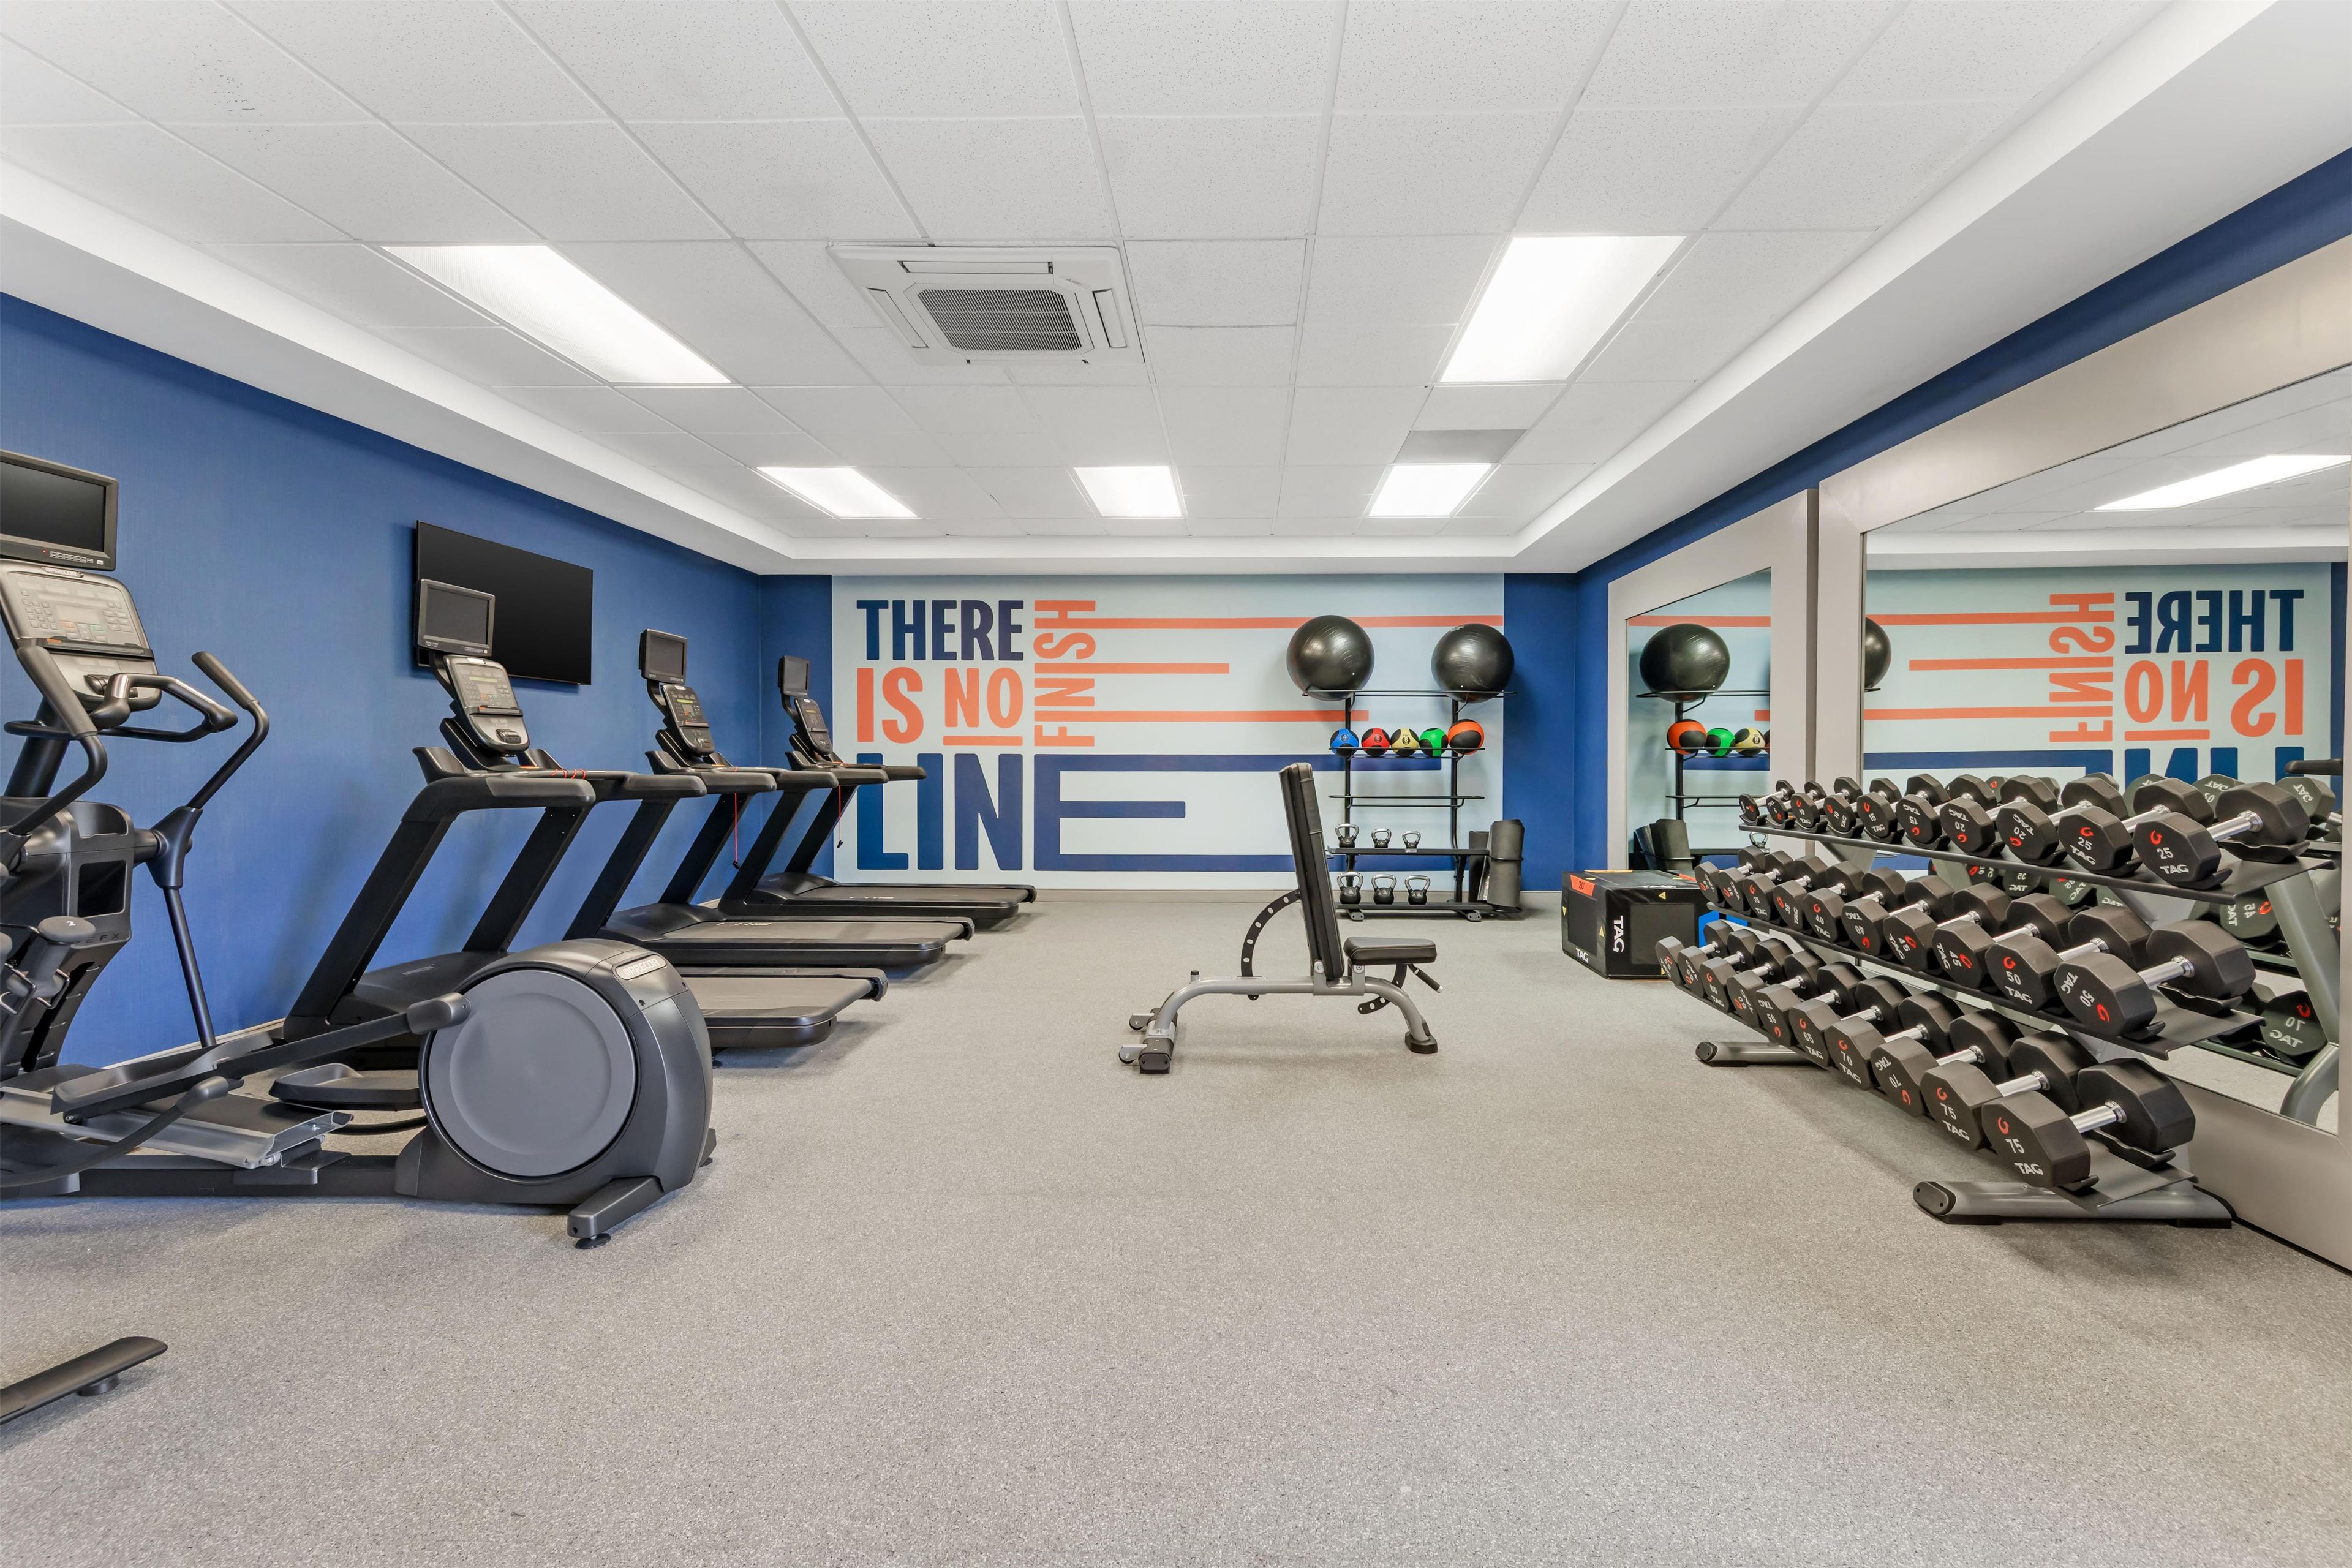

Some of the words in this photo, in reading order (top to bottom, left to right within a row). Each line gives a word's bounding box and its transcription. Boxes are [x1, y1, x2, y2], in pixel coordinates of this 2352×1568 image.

[857, 600, 1024, 660] THERE
[1033, 600, 1096, 747] FINISH
[857, 667, 924, 744] IS
[944, 668, 1024, 728] NO
[1903, 804, 1921, 815] TAG
[1948, 809, 1969, 821] TAG
[1909, 816, 1918, 825] 15
[1954, 821, 1965, 832] 20
[2013, 813, 2034, 835] TAG
[2014, 827, 2026, 839] 20
[2078, 837, 2092, 850] 25
[2070, 845, 2096, 865] TAG
[2157, 847, 2174, 859] 25
[2160, 864, 2189, 875] TAG
[1815, 914, 1825, 925] 40
[1845, 912, 1863, 921] TAG
[1613, 915, 1624, 953] TAG
[1814, 924, 1831, 938] TAG
[1855, 925, 1864, 935] 40
[1888, 933, 1906, 960] TAG
[1898, 937, 1910, 952] 45
[1575, 948, 1589, 963] TAG
[1936, 943, 1951, 970] TAG
[1949, 951, 1962, 967] 45
[628, 958, 660, 975] PRECOR
[2006, 971, 2021, 986] 50
[2060, 972, 2078, 995] TAG
[1712, 995, 1725, 1008] TAG
[2004, 986, 2033, 1005] TAG
[2079, 990, 2095, 1008] 50
[1758, 999, 1773, 1009] TAG
[1766, 1013, 1776, 1023] 65
[1803, 1031, 1814, 1044] 65
[1805, 1046, 1823, 1060] TAG
[1841, 1050, 1853, 1066] 70
[1875, 1057, 1891, 1071] TAG
[1839, 1063, 1861, 1084] TAG
[1888, 1074, 1902, 1088] 70
[1940, 1103, 1956, 1120] 75
[1942, 1120, 1970, 1141] TAG
[2005, 1139, 2024, 1154] 75
[2014, 1163, 2044, 1175] TAG
